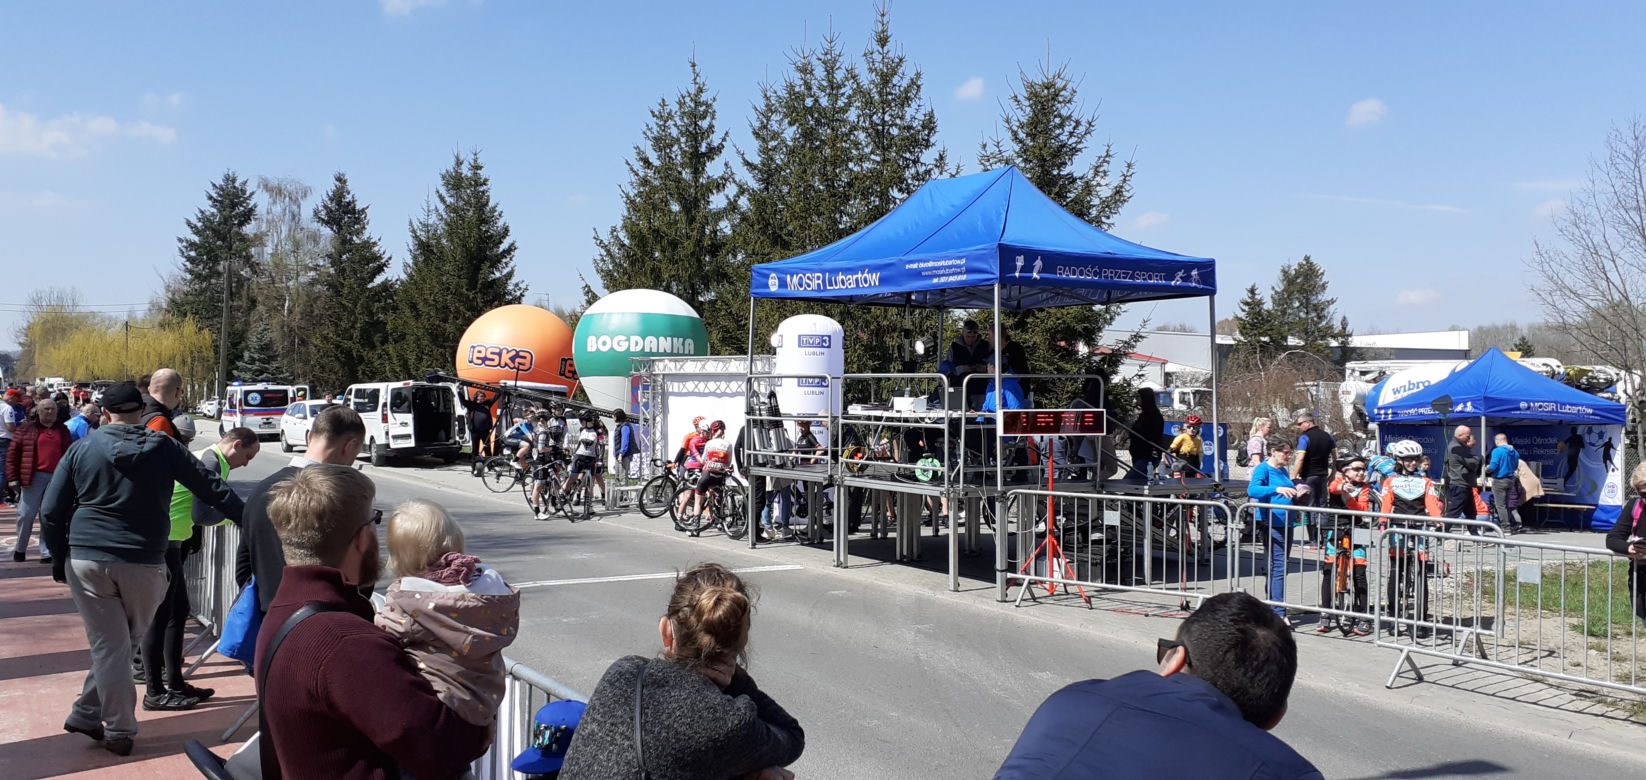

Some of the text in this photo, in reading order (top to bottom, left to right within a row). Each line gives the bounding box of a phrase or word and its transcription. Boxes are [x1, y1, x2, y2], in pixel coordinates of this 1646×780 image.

[786, 273, 824, 291] MOSiR
[825, 268, 880, 289] Lubartów
[1057, 265, 1166, 283] RADOŚĆ PRZEZ SPORT
[587, 335, 694, 355] BOGDANKA
[1392, 380, 1431, 396] wibro
[1557, 403, 1593, 415] Lubartów
